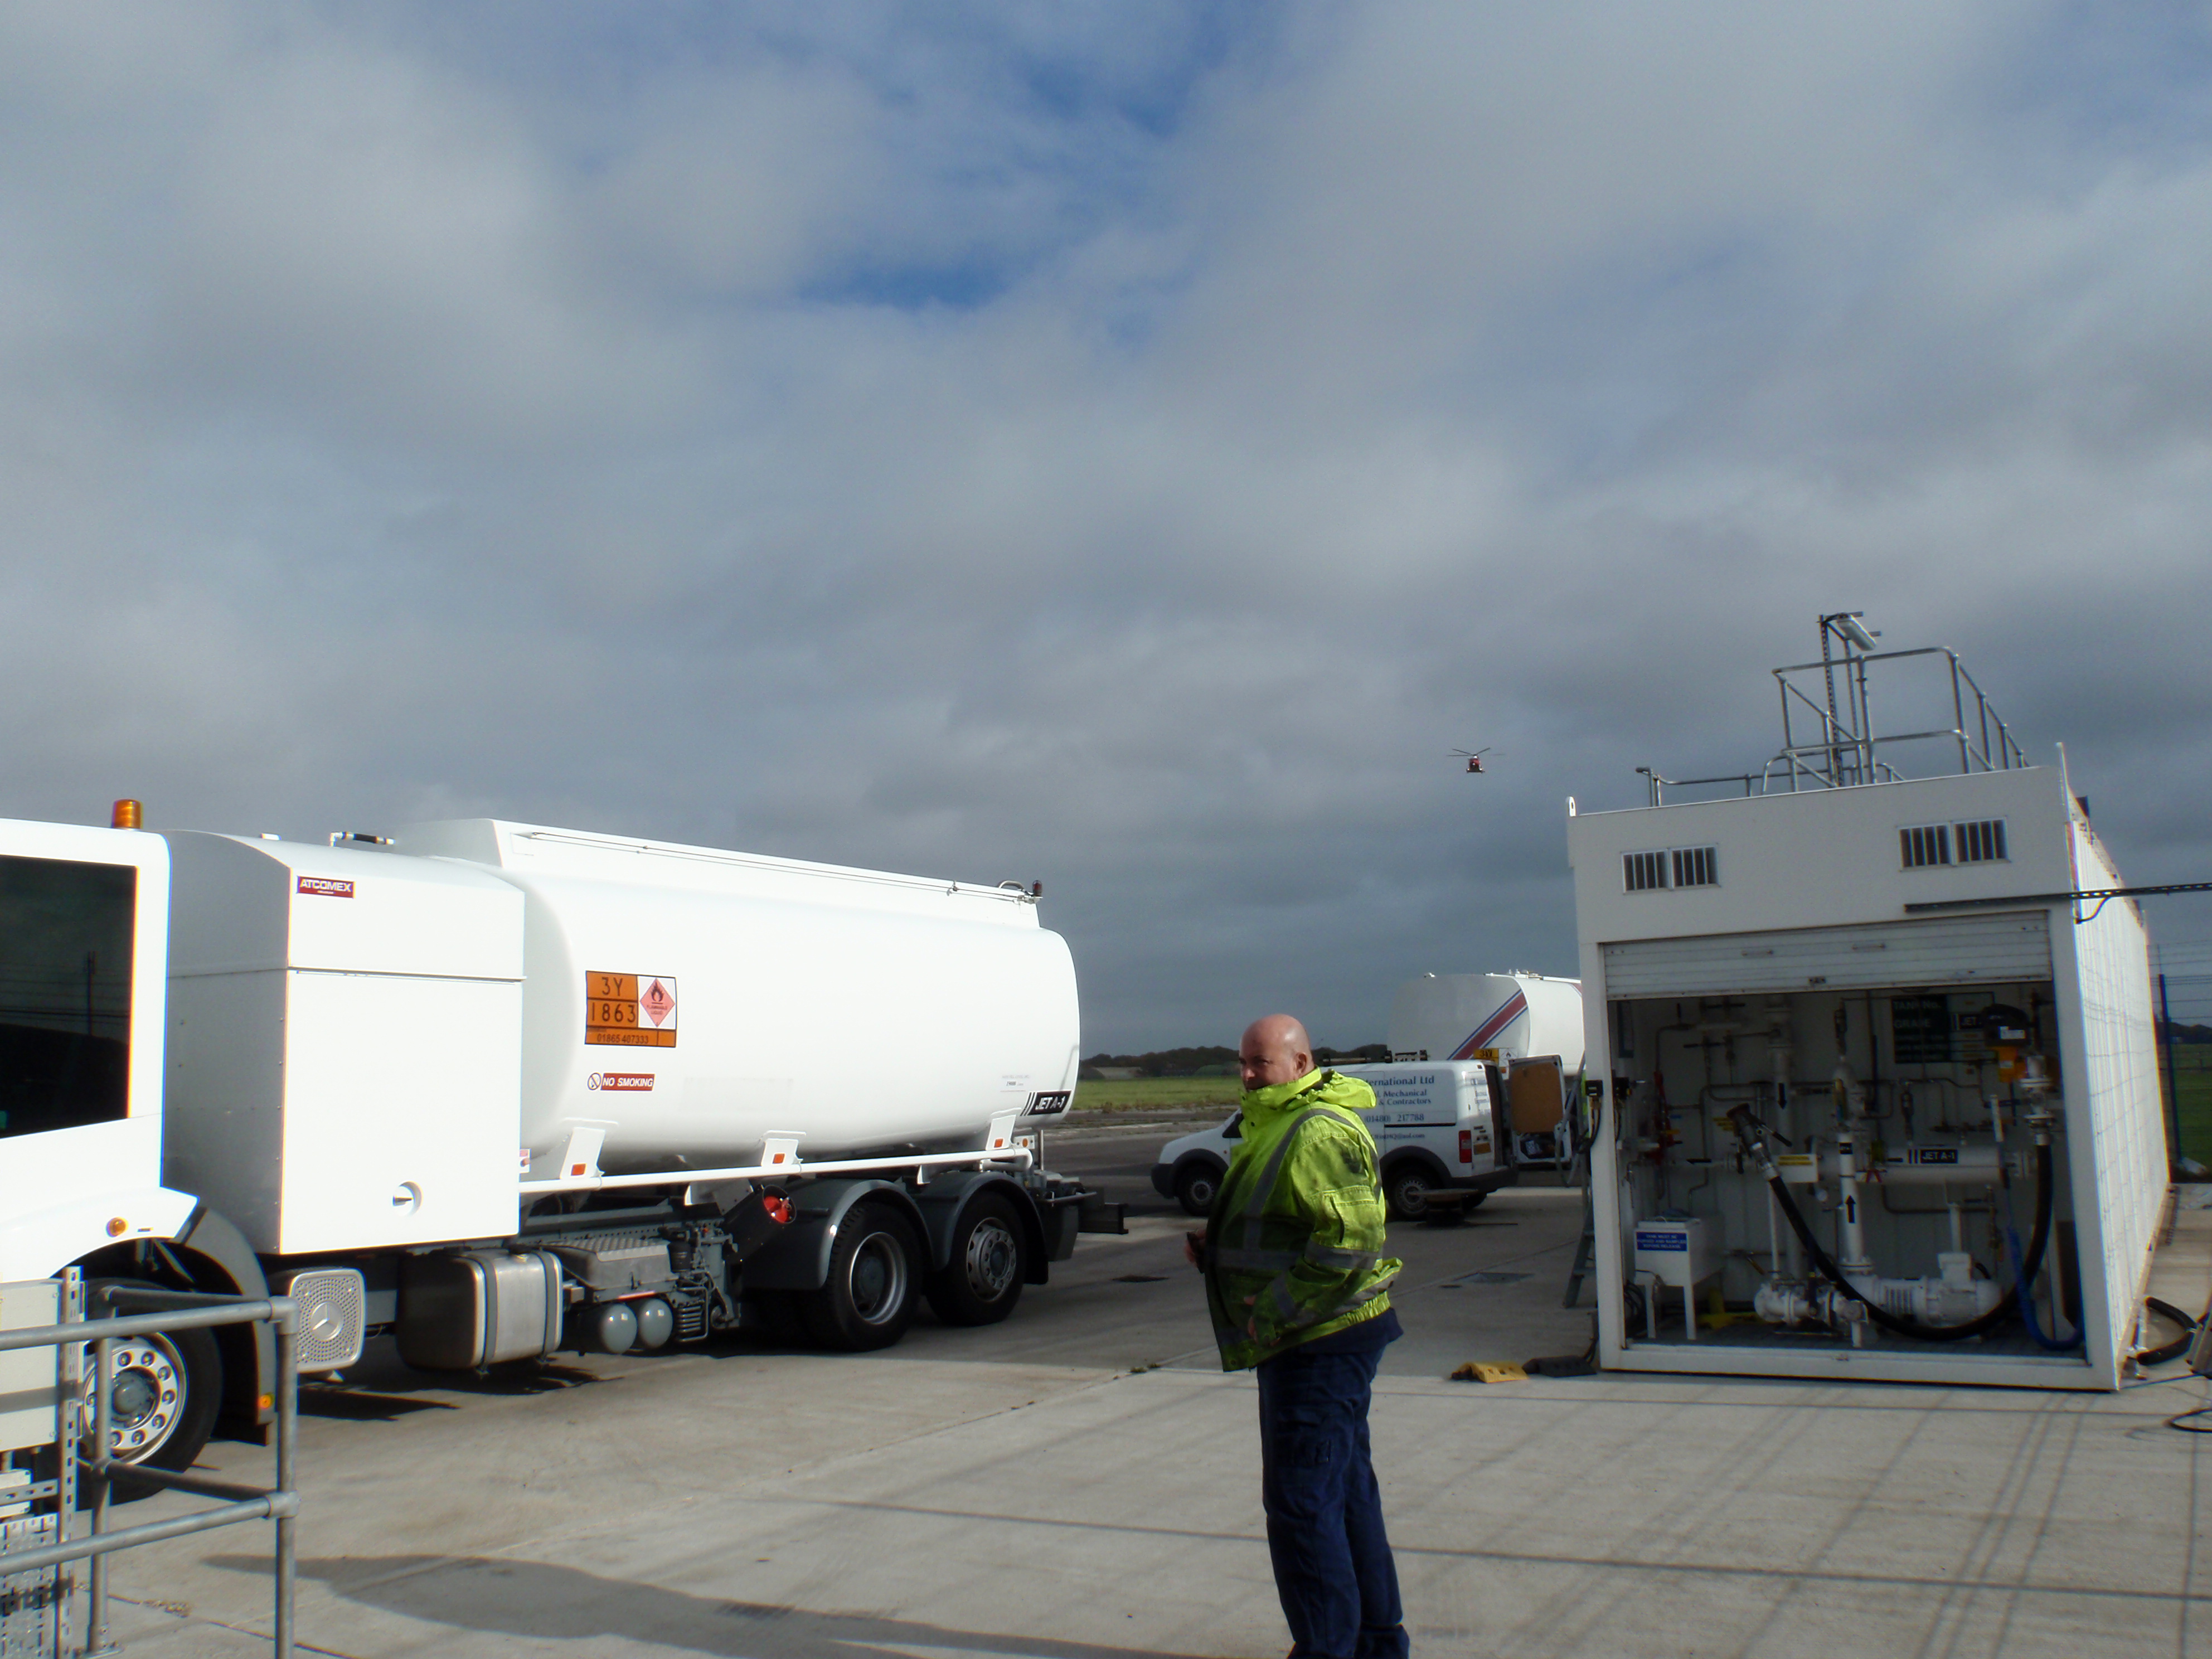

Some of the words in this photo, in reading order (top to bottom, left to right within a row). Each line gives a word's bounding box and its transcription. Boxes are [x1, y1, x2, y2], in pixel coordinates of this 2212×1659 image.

[299, 879, 352, 892] ATCOMEX
[601, 977, 623, 996] 3Y
[592, 1003, 636, 1022] 1863
[596, 1033, 620, 1043] 01865
[622, 1034, 649, 1044] 407333
[602, 1077, 615, 1086] NO
[617, 1078, 653, 1087] SMOKING
[1366, 1076, 1417, 1086] ternational
[1420, 1075, 1434, 1084] Ltd
[1384, 1089, 1427, 1098] Mechanical
[1035, 1097, 1053, 1110] JET
[1050, 1095, 1066, 1109] A-1
[1398, 1113, 1424, 1122] 217788
[1941, 1151, 1954, 1160] A-1
